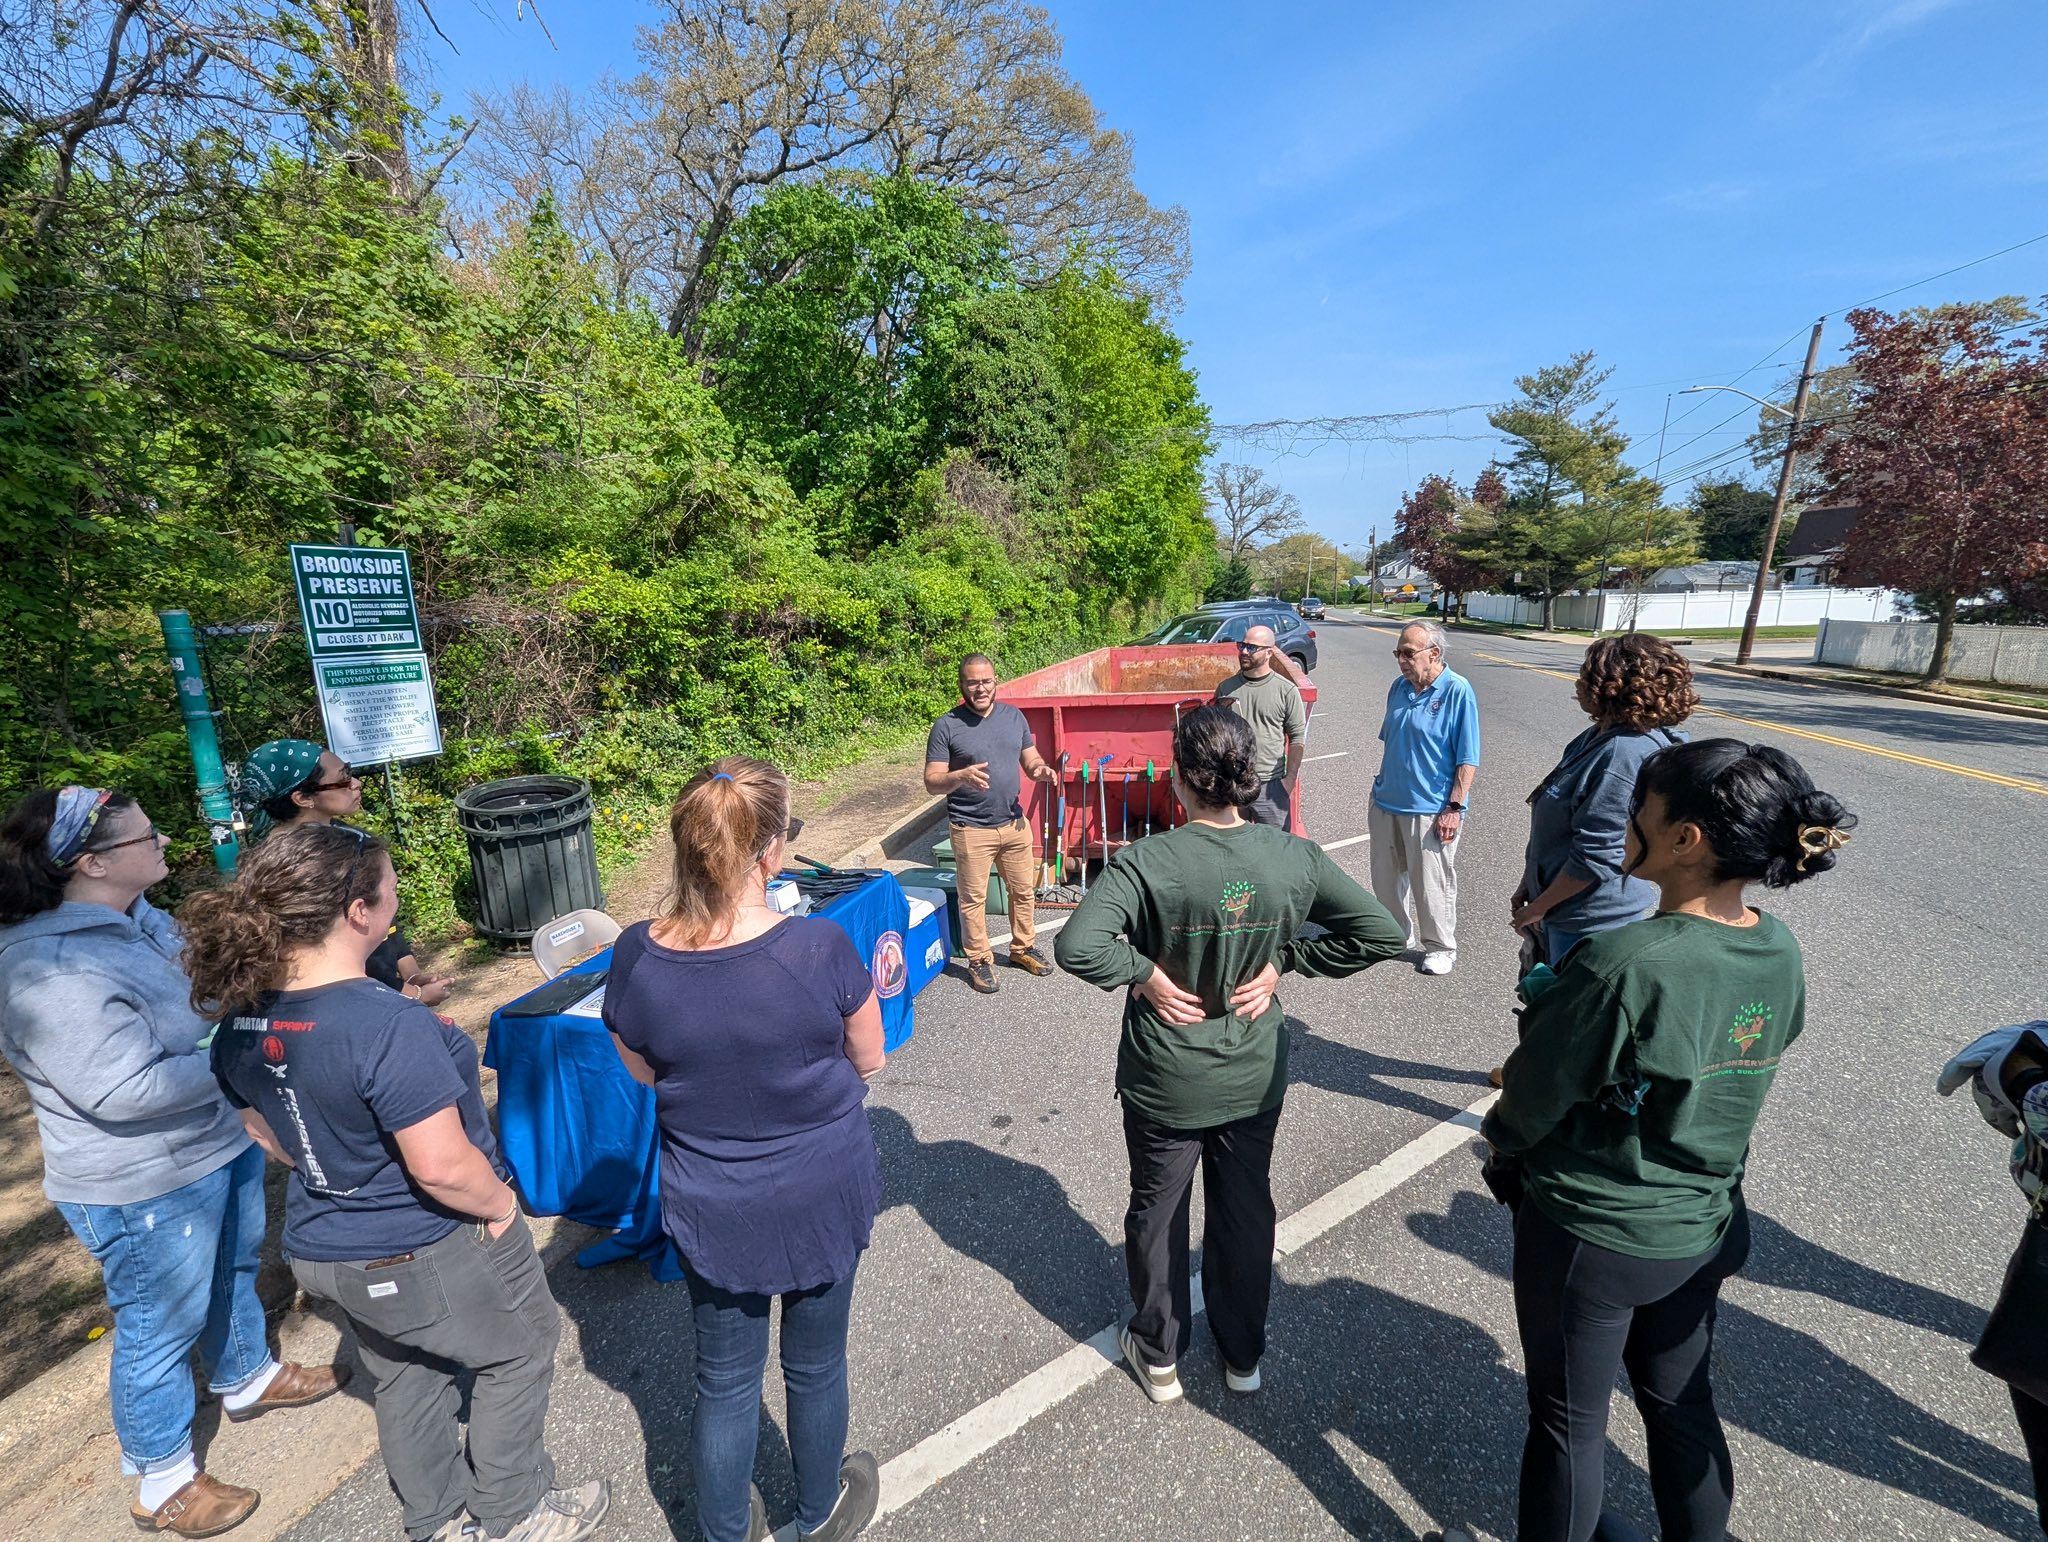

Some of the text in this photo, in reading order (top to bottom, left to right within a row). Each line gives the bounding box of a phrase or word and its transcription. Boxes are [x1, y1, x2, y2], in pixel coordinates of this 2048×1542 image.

[301, 555, 403, 575] BROOKSIDE
[309, 577, 403, 595] PRESERVE
[314, 601, 350, 625] NO
[327, 633, 406, 645] CLOSES AT DARK
[326, 669, 344, 677] THIS
[345, 666, 381, 676] PRESERVE
[389, 665, 404, 673] FOR
[331, 675, 375, 685] ENJOYMENT
[387, 672, 417, 680] NATURE
[347, 690, 367, 698] STOP
[384, 687, 408, 695] LISTEN
[339, 697, 371, 707] OBSERVE
[387, 694, 418, 702] WILDLIFE
[346, 706, 368, 715] SMELL
[384, 702, 416, 711] FLOWERS
[359, 712, 383, 721] TRASH
[393, 709, 420, 717] PROPER
[361, 717, 405, 727] RECEPTACLE
[353, 723, 417, 736] PERSUADE OTHERS
[233, 1016, 317, 1032] SPARTAN SPRINT
[284, 1087, 328, 1187] FINISHER
